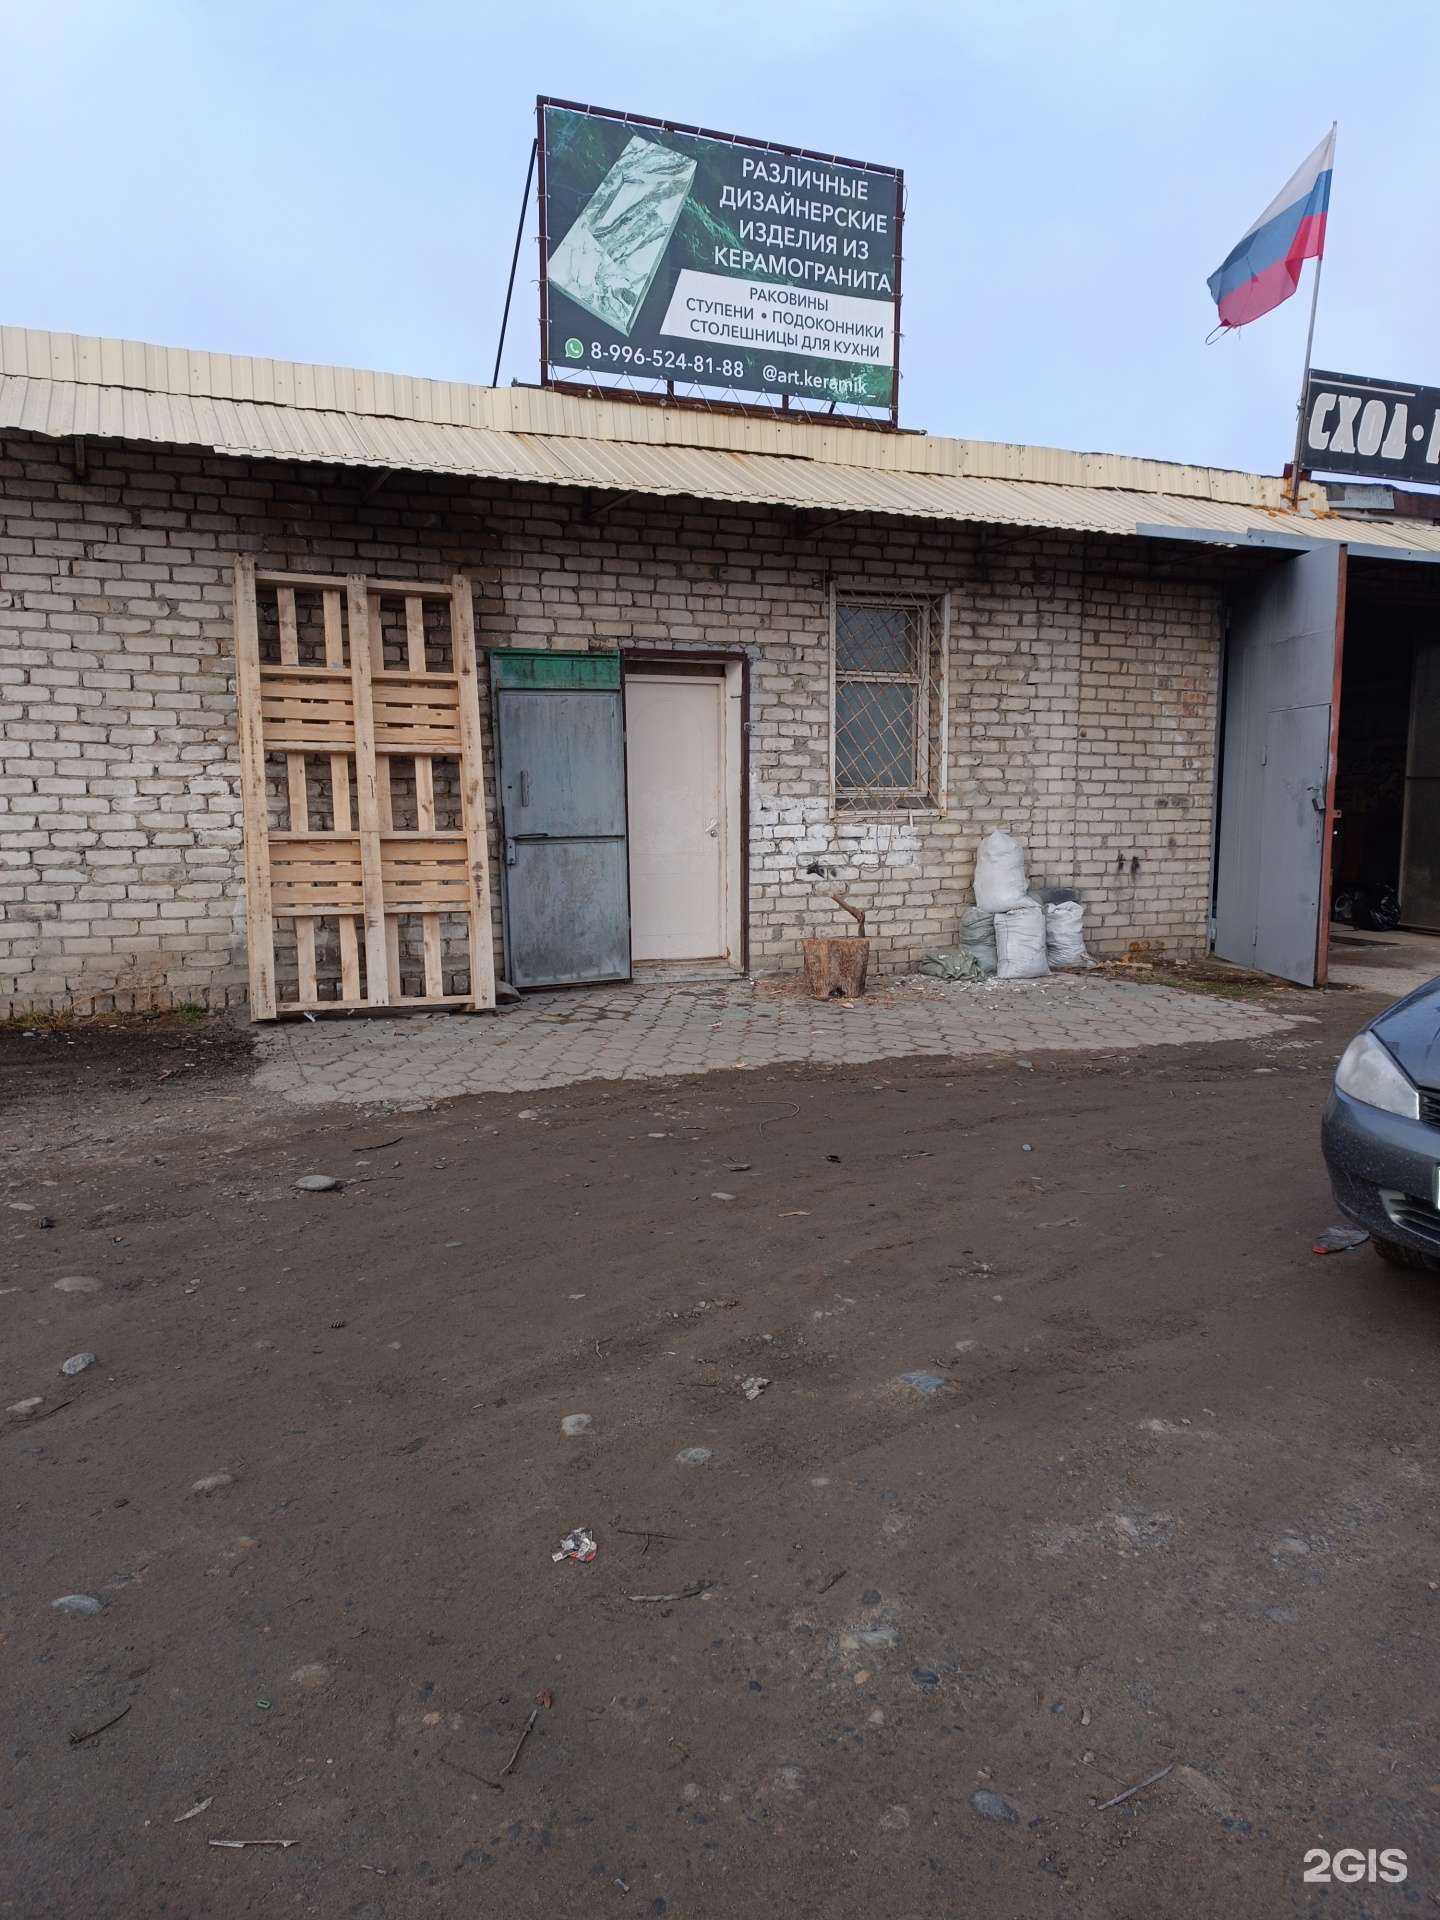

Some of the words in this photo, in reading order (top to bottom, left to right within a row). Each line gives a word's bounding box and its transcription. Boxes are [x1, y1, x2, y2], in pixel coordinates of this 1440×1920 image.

[742, 158, 868, 200] РАЗЛИЧНЫЕ
[719, 185, 888, 234] ДИЗАЙНЕРСКИЕ
[739, 219, 836, 255] ИЗДЕЛИЯ
[843, 238, 869, 260] ИЗ
[714, 246, 892, 293] КЕРАМОГРАНИТА
[686, 297, 754, 321] СТУПЕНИ
[772, 311, 884, 339] ПОДОКОННИКИ
[750, 287, 828, 311] РАКОВИНЫ
[690, 319, 798, 347] СТОЛЕШНИЦЫ
[801, 335, 830, 352] ДЛЯ
[834, 340, 880, 358] КУХНИ
[591, 342, 744, 378] 8-996-524-81-88
